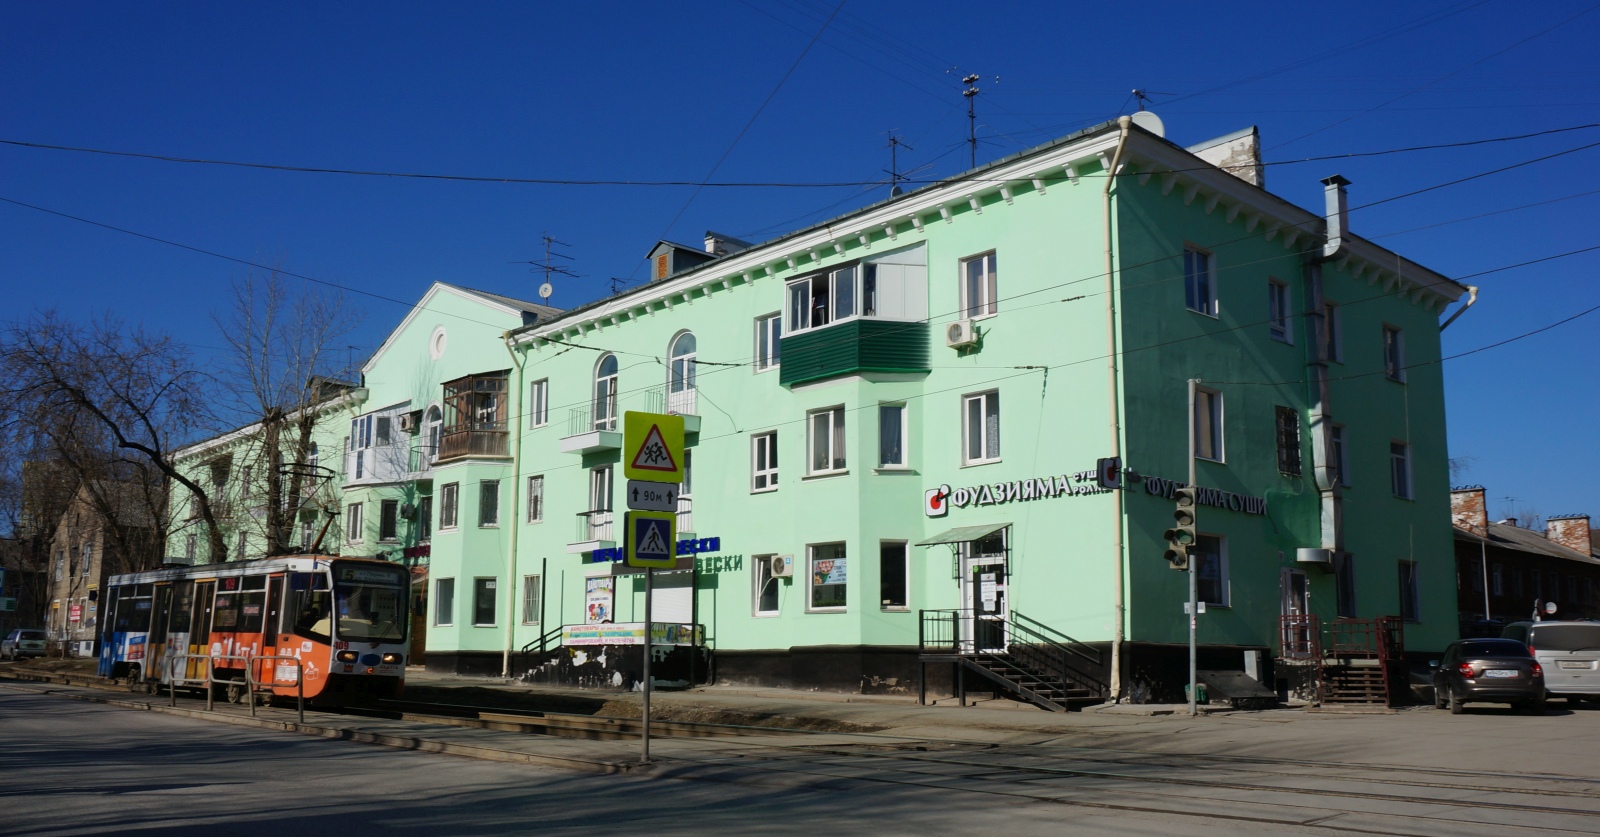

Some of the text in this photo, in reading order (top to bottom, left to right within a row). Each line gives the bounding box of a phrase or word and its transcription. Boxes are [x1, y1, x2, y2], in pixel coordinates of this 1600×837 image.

[1073, 471, 1098, 480] СУШ
[644, 490, 662, 502] 90м
[951, 475, 1072, 507] ФУДЗИЯМА
[1146, 477, 1267, 515] ФУДЯМА СУШИ
[345, 569, 354, 581] 5
[335, 641, 349, 650] 109
